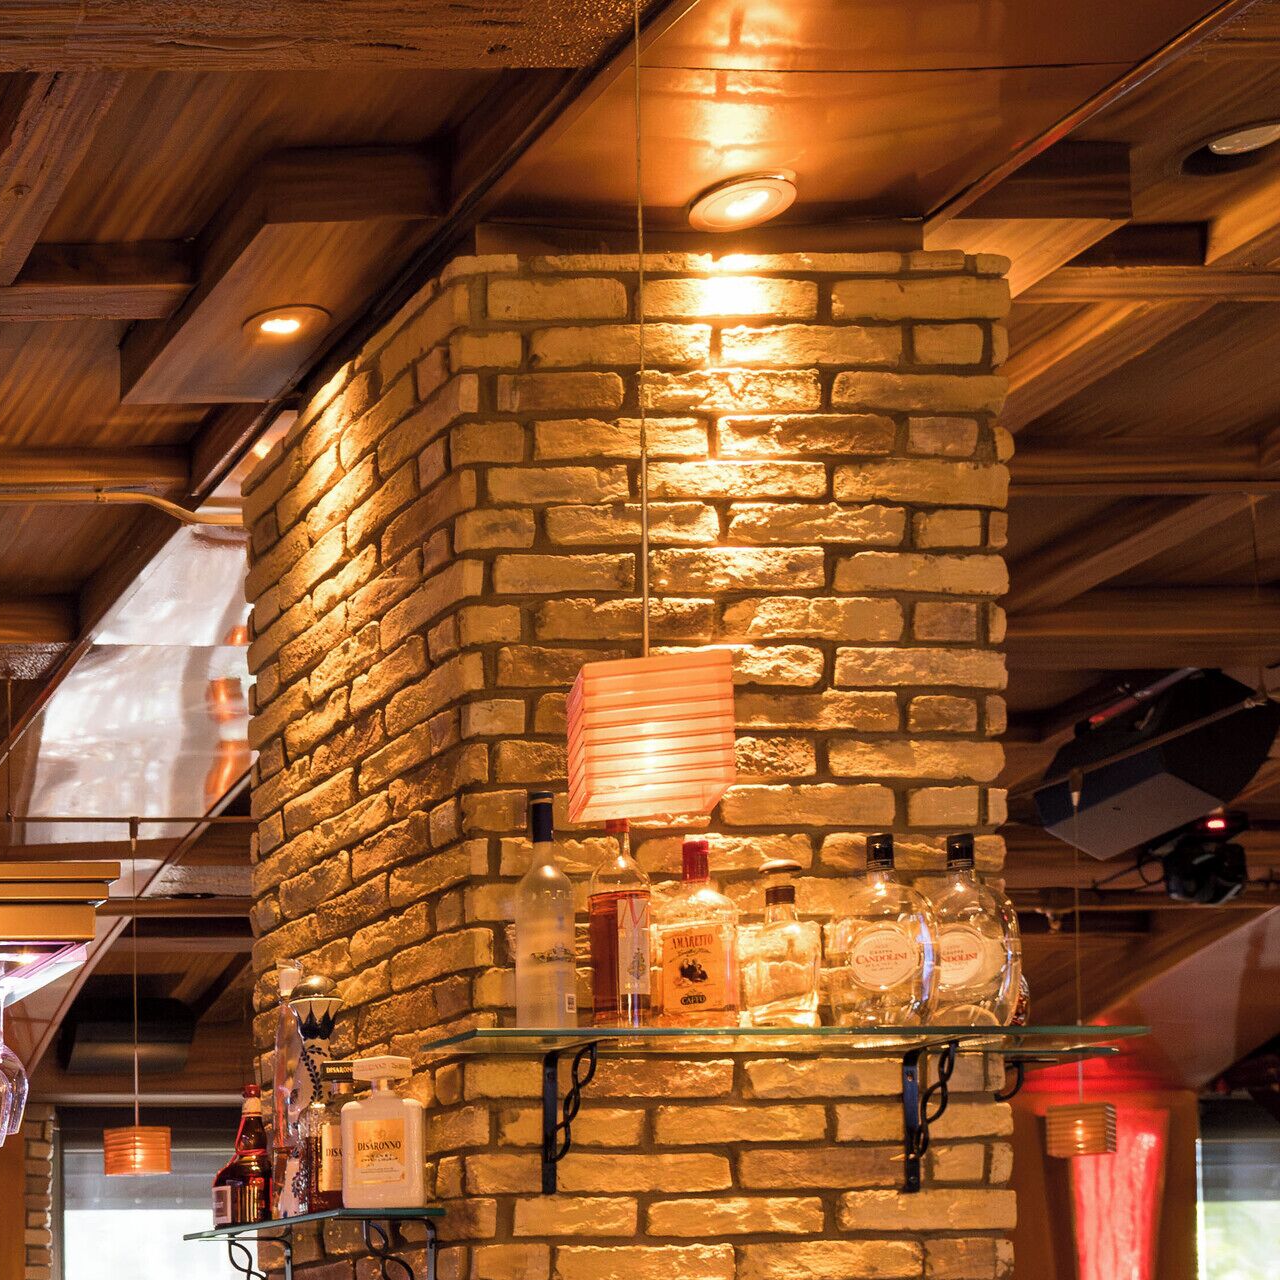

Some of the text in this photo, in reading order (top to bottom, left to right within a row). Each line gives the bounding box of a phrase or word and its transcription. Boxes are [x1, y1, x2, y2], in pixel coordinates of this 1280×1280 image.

[671, 935, 713, 949] AMARETTO
[358, 1141, 401, 1151] DISARONNO
[326, 1149, 342, 1157] DISA
